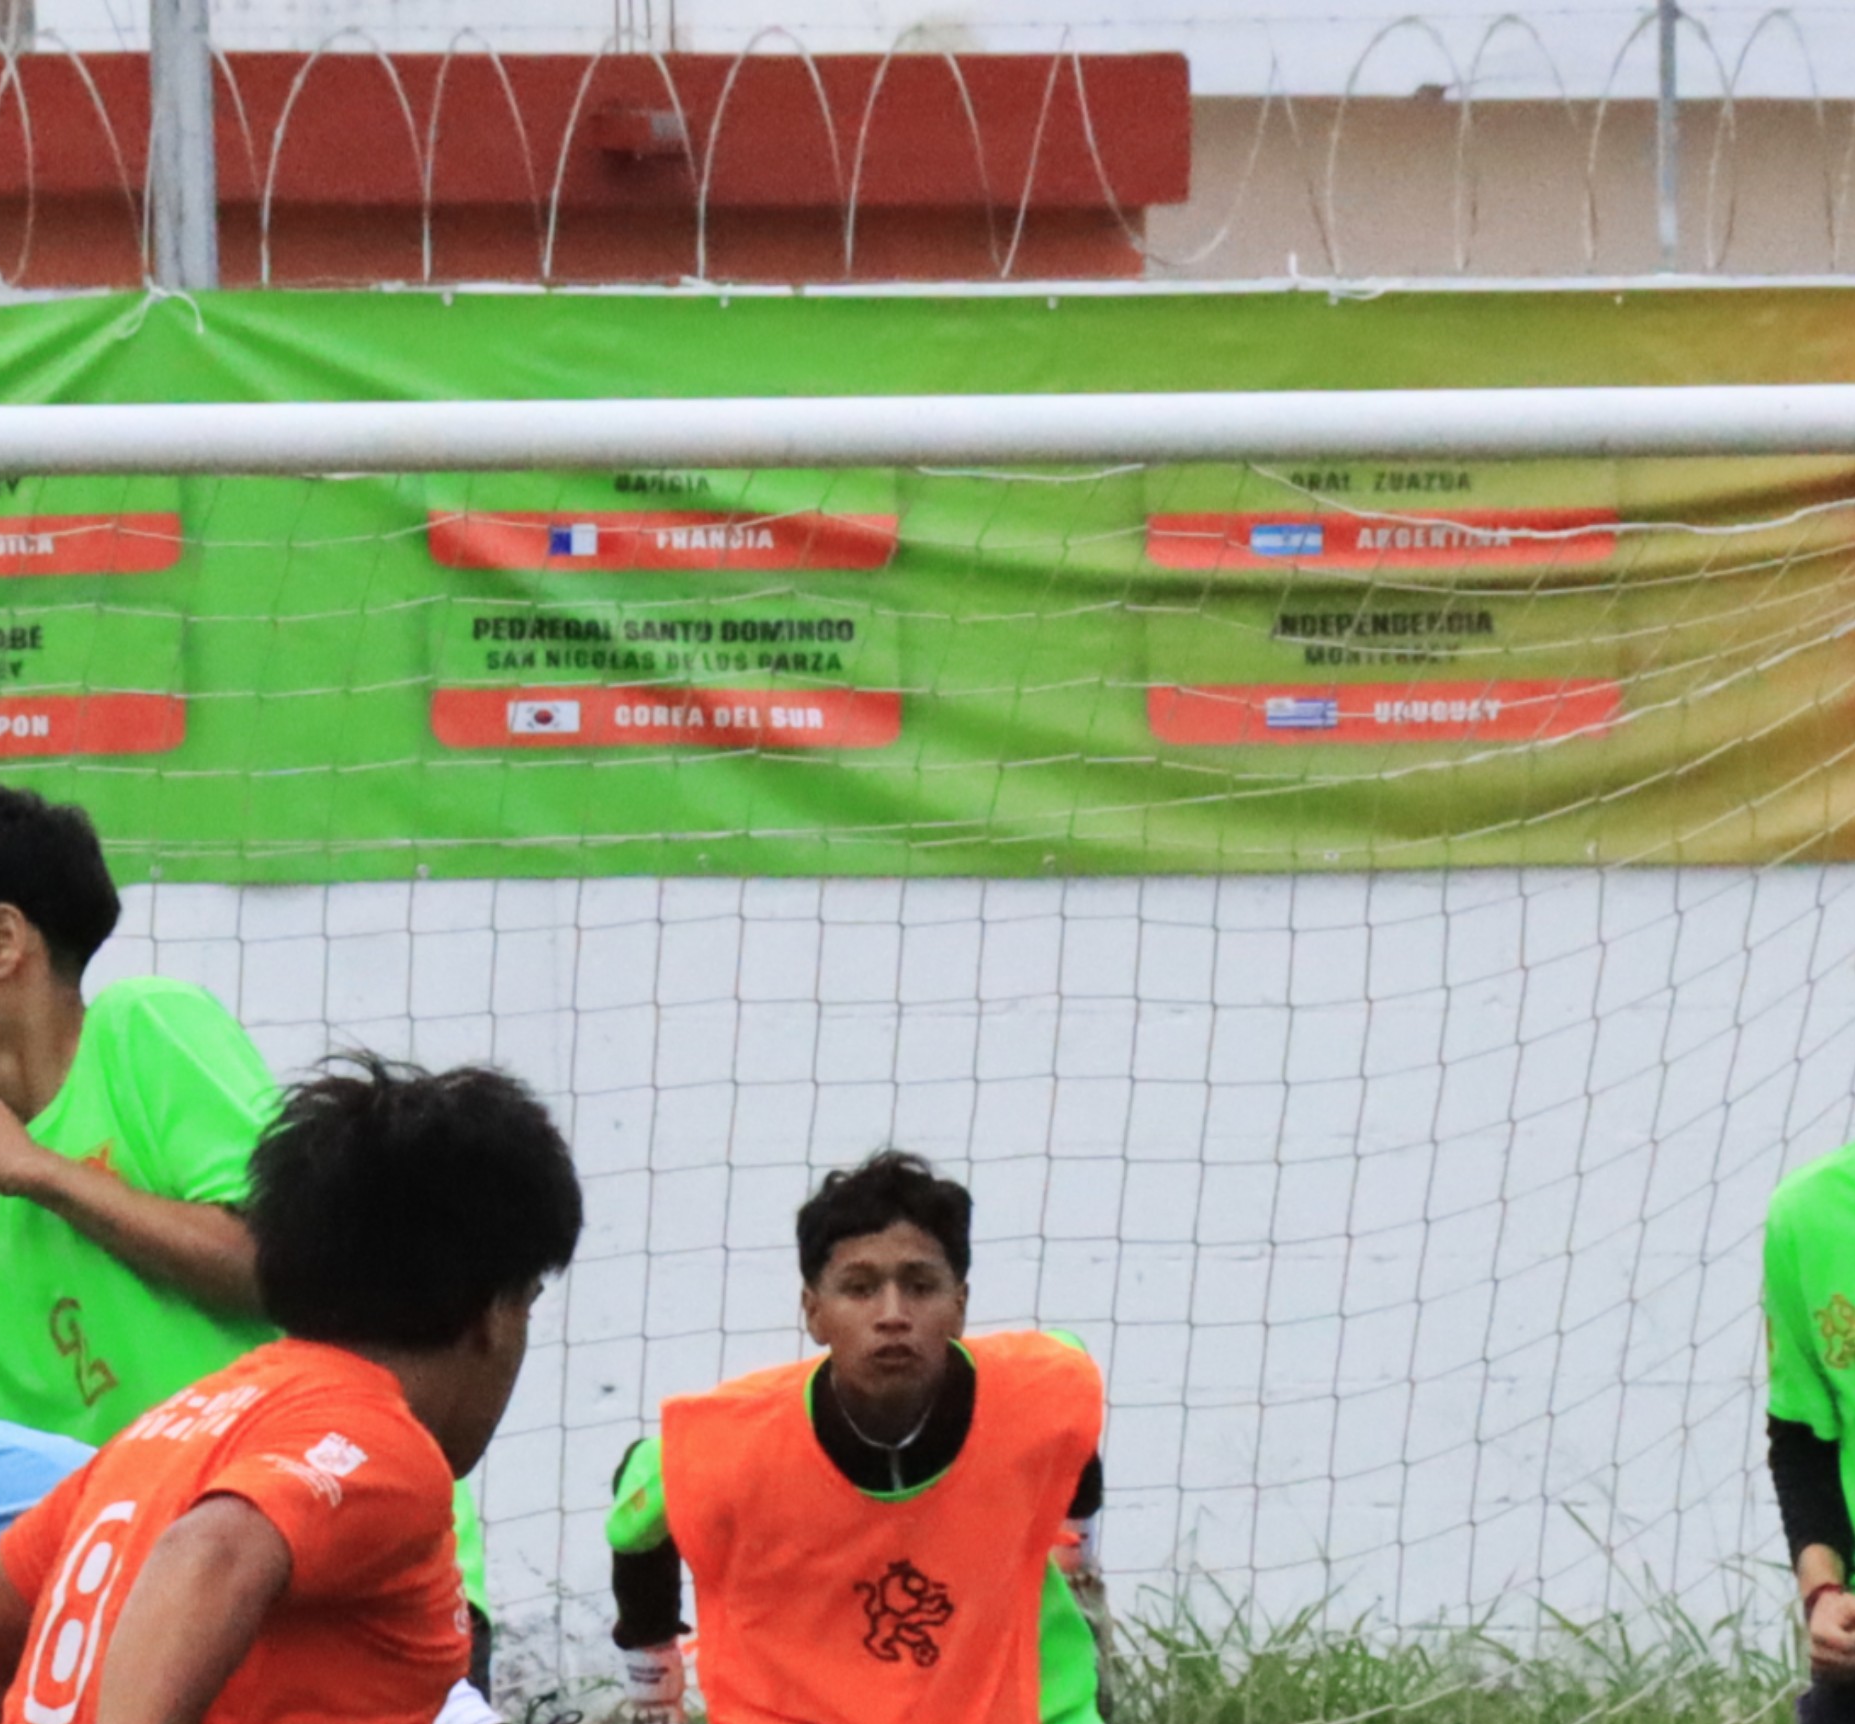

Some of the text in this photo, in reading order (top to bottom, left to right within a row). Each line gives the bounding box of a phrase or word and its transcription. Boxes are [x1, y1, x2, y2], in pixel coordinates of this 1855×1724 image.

[473, 617, 854, 642] PEDREGAL SANTO DOMINGO
[486, 651, 536, 670] SAN
[546, 651, 656, 671] NICOLAS
[615, 704, 825, 730] COREA DEL SUR
[1374, 699, 1502, 724] URUGUAY
